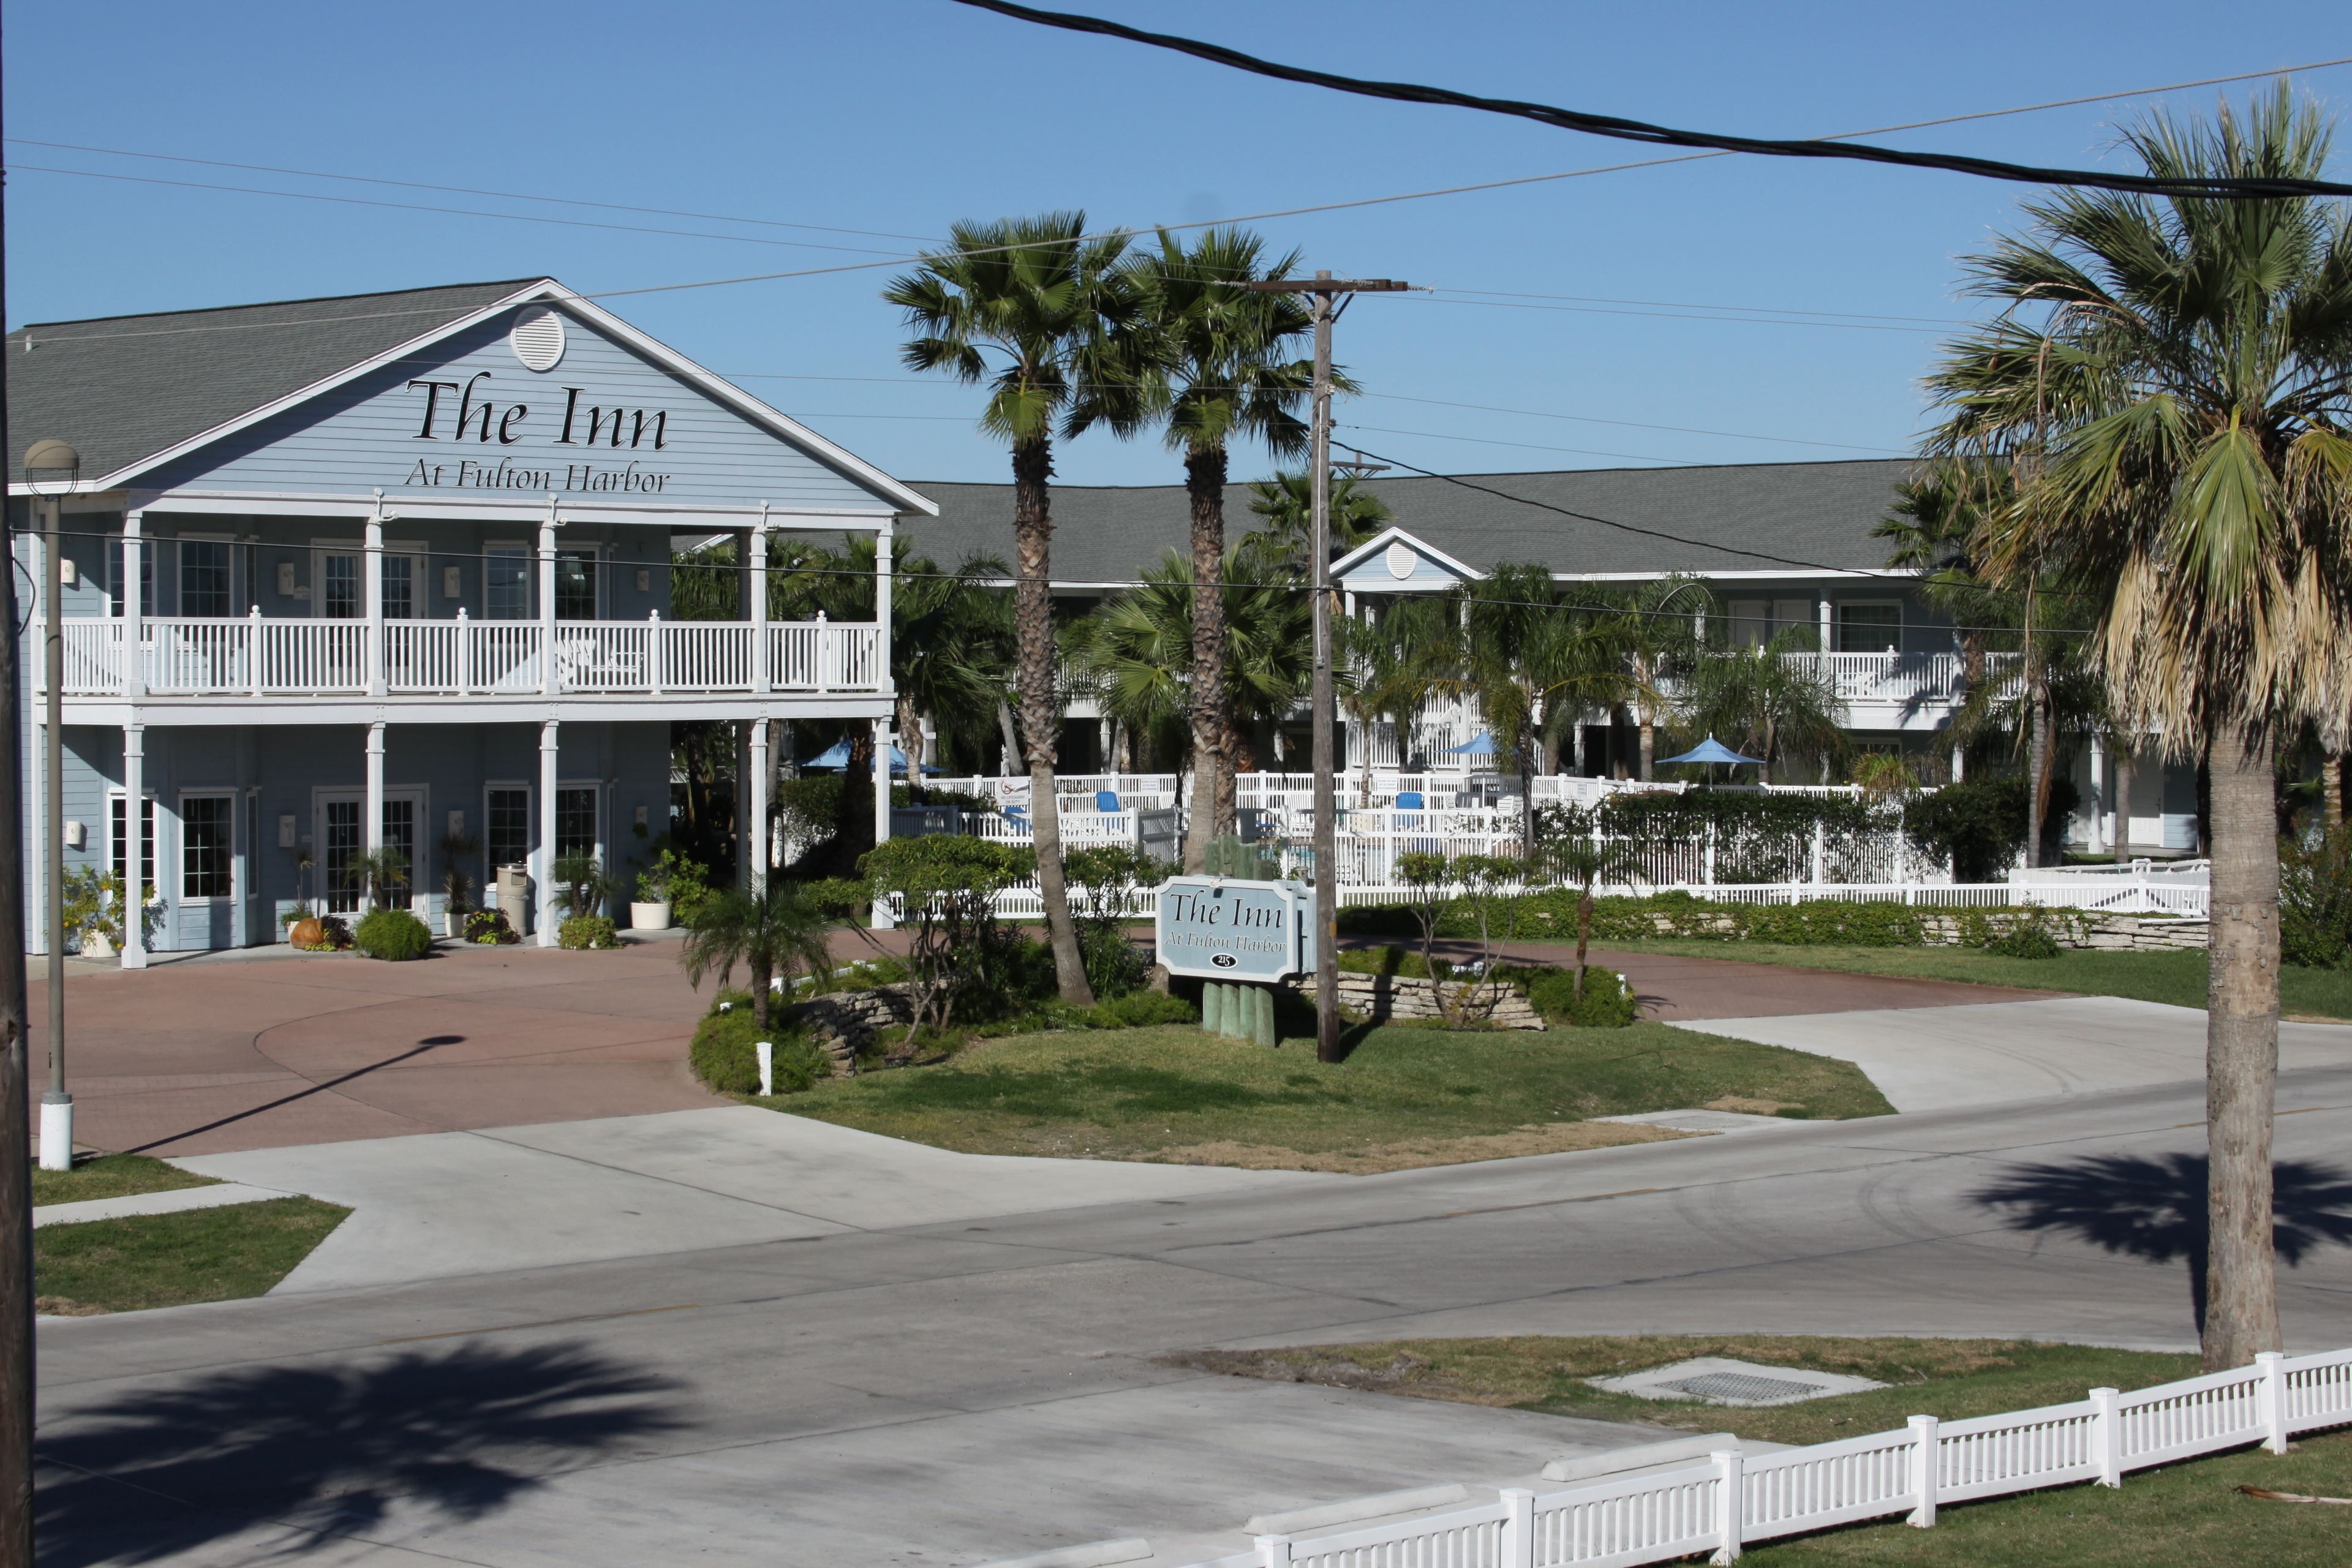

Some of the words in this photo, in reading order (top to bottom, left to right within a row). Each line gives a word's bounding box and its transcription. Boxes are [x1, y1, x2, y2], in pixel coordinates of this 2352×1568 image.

[405, 371, 528, 446] The
[552, 386, 669, 452] Inn
[402, 458, 445, 487] At
[453, 456, 551, 490] Fulton
[562, 459, 671, 493] Harbor
[1169, 889, 1221, 924] The
[1229, 897, 1283, 929] Inn
[1165, 931, 1183, 946] At
[1185, 930, 1230, 948] Fulton
[1234, 935, 1286, 953] Harbor
[1218, 955, 1230, 967] 215
